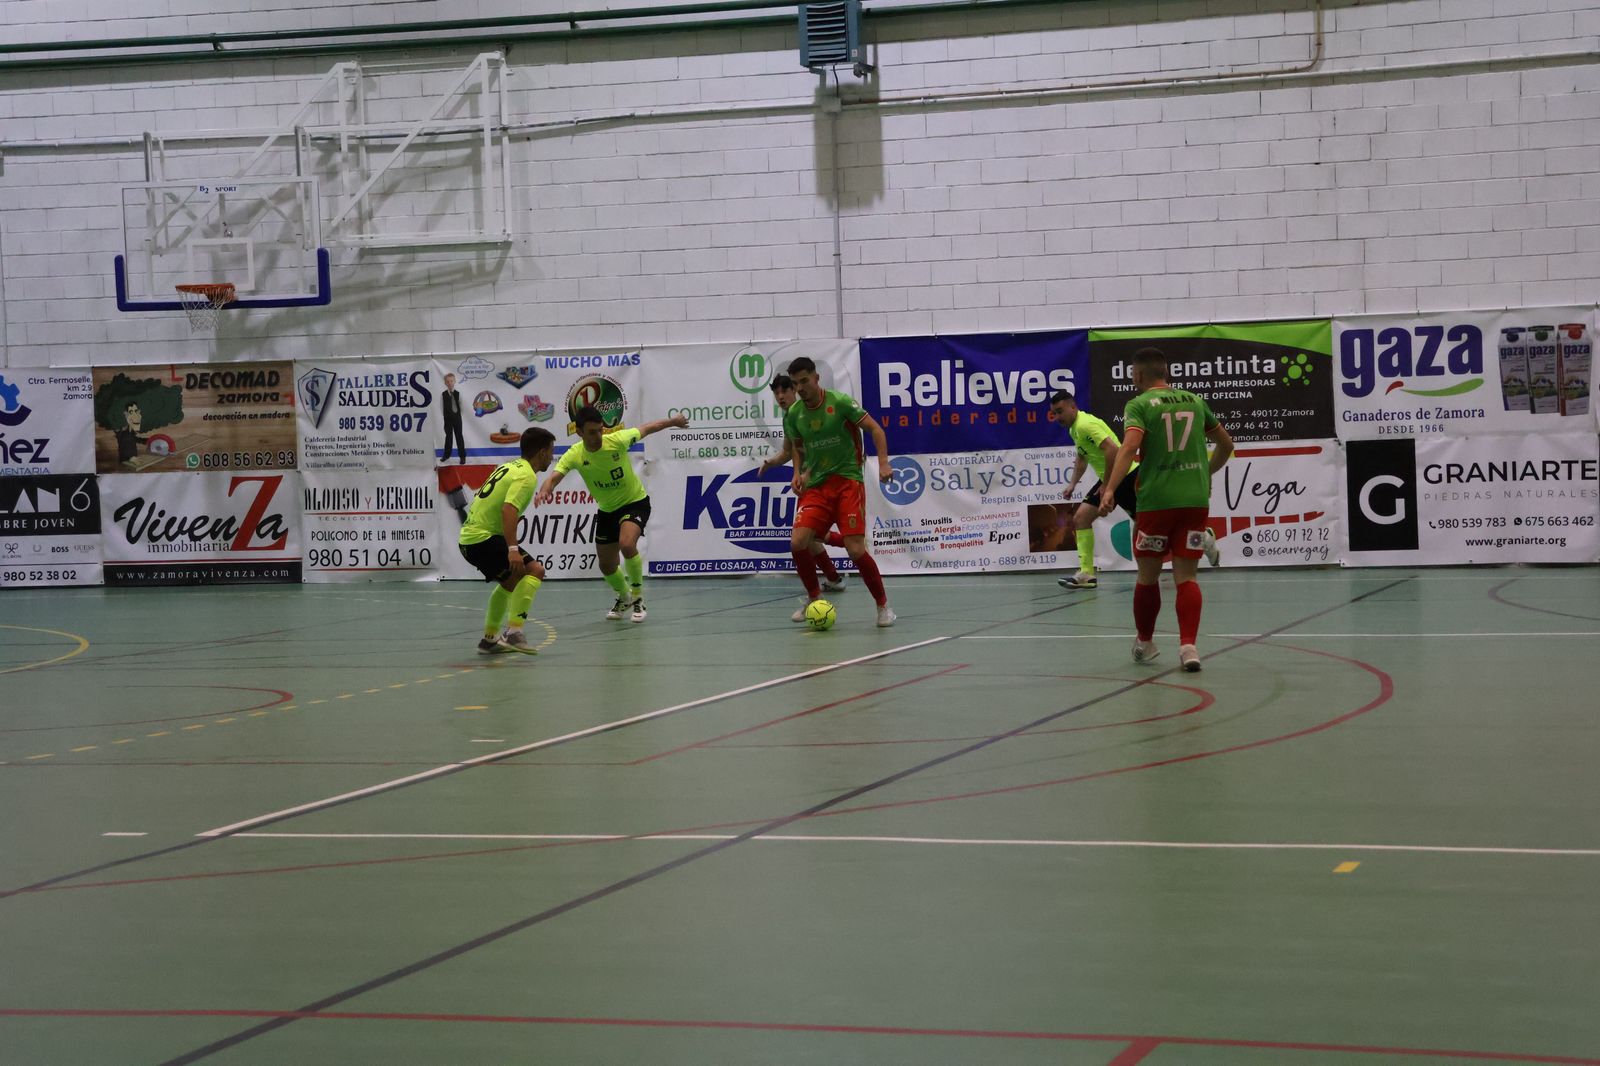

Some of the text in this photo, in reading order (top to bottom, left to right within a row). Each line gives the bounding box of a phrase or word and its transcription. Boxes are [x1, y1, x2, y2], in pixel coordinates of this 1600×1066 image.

[1500, 346, 1524, 359] gaza
[1529, 345, 1555, 359] gaza
[1564, 344, 1590, 358] gaza
[545, 352, 641, 369] MUCHO MÁS
[1112, 354, 1276, 380] deenatinta
[1340, 324, 1483, 398] gaza
[185, 370, 280, 390] DECOMAD
[878, 359, 1076, 408] Relieves
[1112, 379, 1276, 392] TINT PARA IMPRESORAS
[216, 391, 280, 404] zamora
[1212, 391, 1252, 400] OFICINA
[202, 411, 291, 422] decoración en madera
[668, 400, 765, 421] comercial
[881, 407, 1056, 427] valderadue
[1230, 408, 1315, 419] 25 49012 Zamora
[1342, 407, 1485, 422] Ganaderos de Zamora
[339, 412, 427, 432] 980 539 807
[1224, 420, 1284, 430] 669 46 42 10
[1378, 424, 1444, 434] DESDE 1966
[670, 433, 720, 441] PRODUCTOS
[722, 432, 733, 440] DE
[735, 431, 770, 439] LIMPIEZA
[1161, 411, 1195, 452] 17
[203, 451, 295, 467] 608 56 62 93
[672, 445, 770, 459] Telf. 680 35 87 17
[1024, 451, 1066, 461] Cuevas de
[929, 455, 1004, 466] HALOTERAPIA
[930, 462, 1082, 495] Sal y Salud
[1423, 459, 1598, 484] GRANIARTE
[71, 478, 91, 512] 6
[1225, 462, 1307, 515] Vega
[1424, 489, 1599, 501] PIEDRAS NATURALES
[365, 497, 372, 510] Y
[376, 486, 433, 510] BERNAL
[981, 491, 1083, 505] Respira Vive Sud
[1359, 474, 1406, 525] G
[113, 474, 289, 552] VivenZa
[872, 511, 1020, 529] Asma Sinusitis CONTAMINANTES
[0, 518, 75, 529] BRE JOVEN
[517, 514, 599, 545] ONTIK
[1438, 516, 1594, 529] 980 539 783 675 663 462
[311, 530, 425, 541] POLIGONO DE LA HINIESTA
[872, 529, 902, 539] Faringitis
[873, 530, 1021, 547] Dermatitis Atópica Tabaquismo Epoc
[1257, 529, 1280, 543] 680
[1465, 535, 1566, 547] www.graniarte.org
[147, 540, 230, 554] inmobiliaria
[873, 540, 984, 556] Bronquitis Rinitis Bronquiolitis
[309, 548, 431, 567] 980 51 04 10
[559, 554, 575, 570] 37
[579, 554, 597, 570] 37
[926, 558, 976, 570] Amargura
[979, 557, 990, 566] 10
[999, 556, 1017, 566] 689
[1019, 555, 1037, 565] 874
[1040, 555, 1057, 564] 119
[656, 560, 853, 572] C/ DIEGO DE LOSADA, S/N 58
[3, 570, 77, 581] 980 52 38 02
[116, 568, 289, 580] www.zamoravivenza.com
